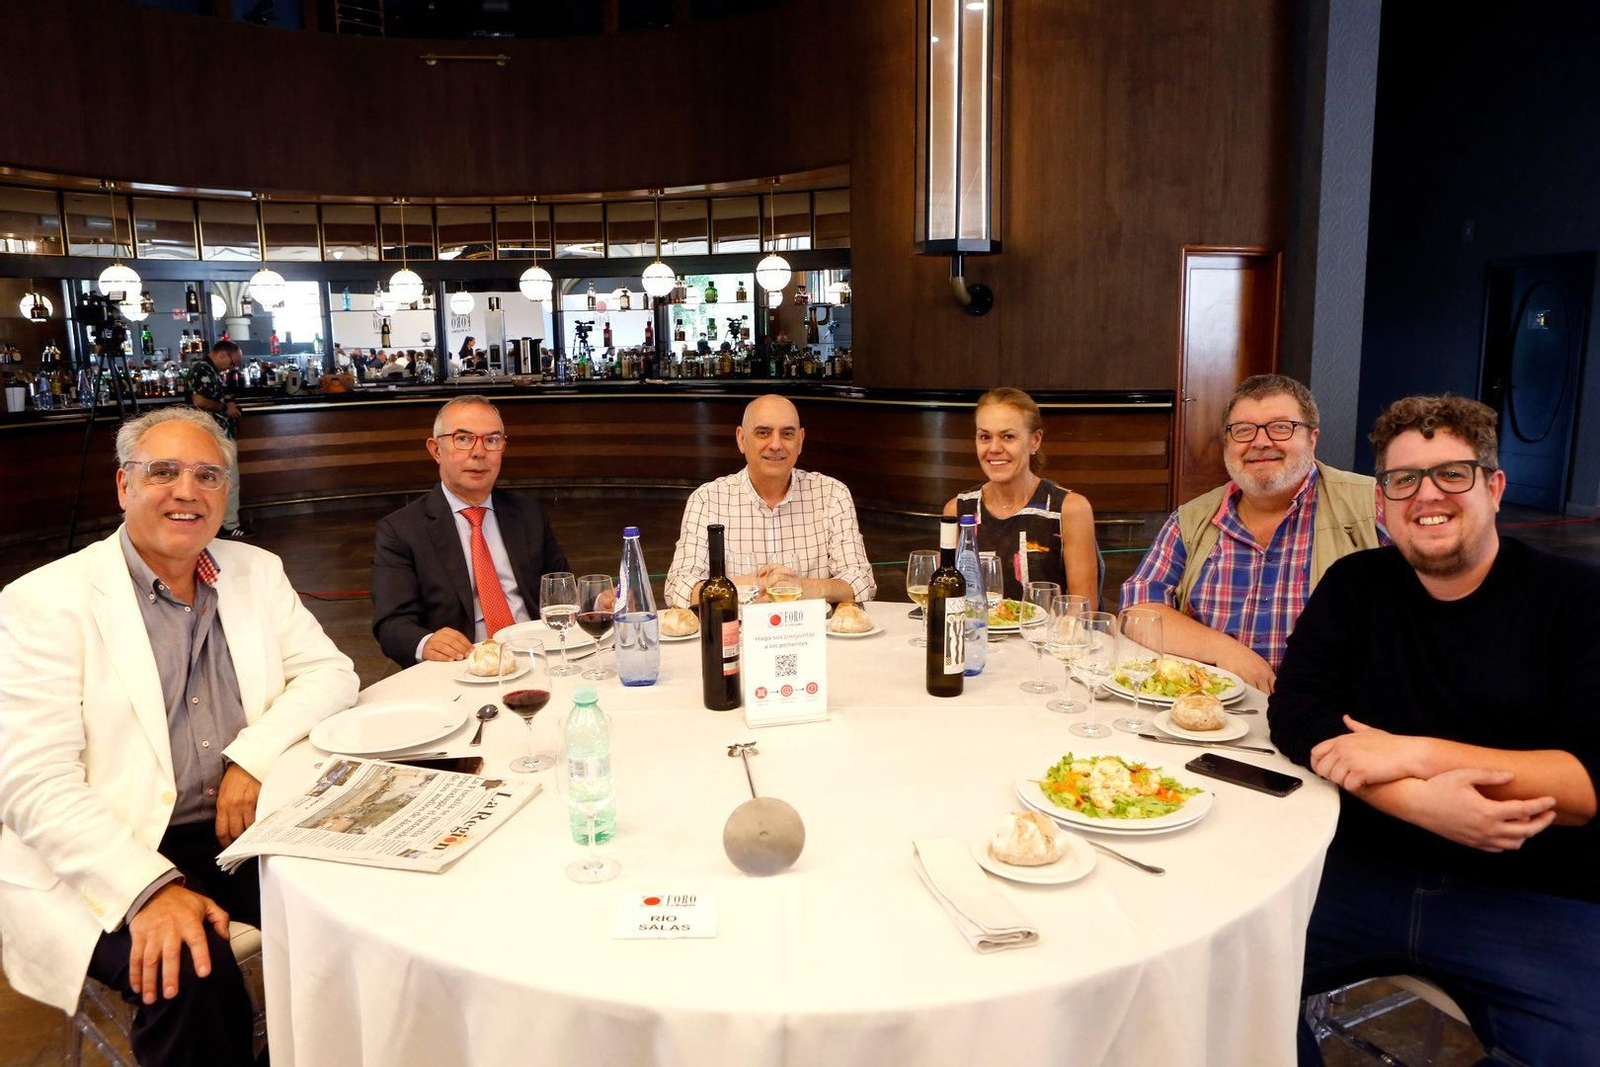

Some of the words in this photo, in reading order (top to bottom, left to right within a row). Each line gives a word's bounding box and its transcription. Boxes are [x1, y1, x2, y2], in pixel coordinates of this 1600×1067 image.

[784, 611, 804, 623] FORO
[783, 632, 815, 641] preguntas
[779, 641, 808, 649] ponentes
[484, 792, 513, 809] La
[666, 894, 697, 907] FORO
[650, 914, 677, 922] RÍO
